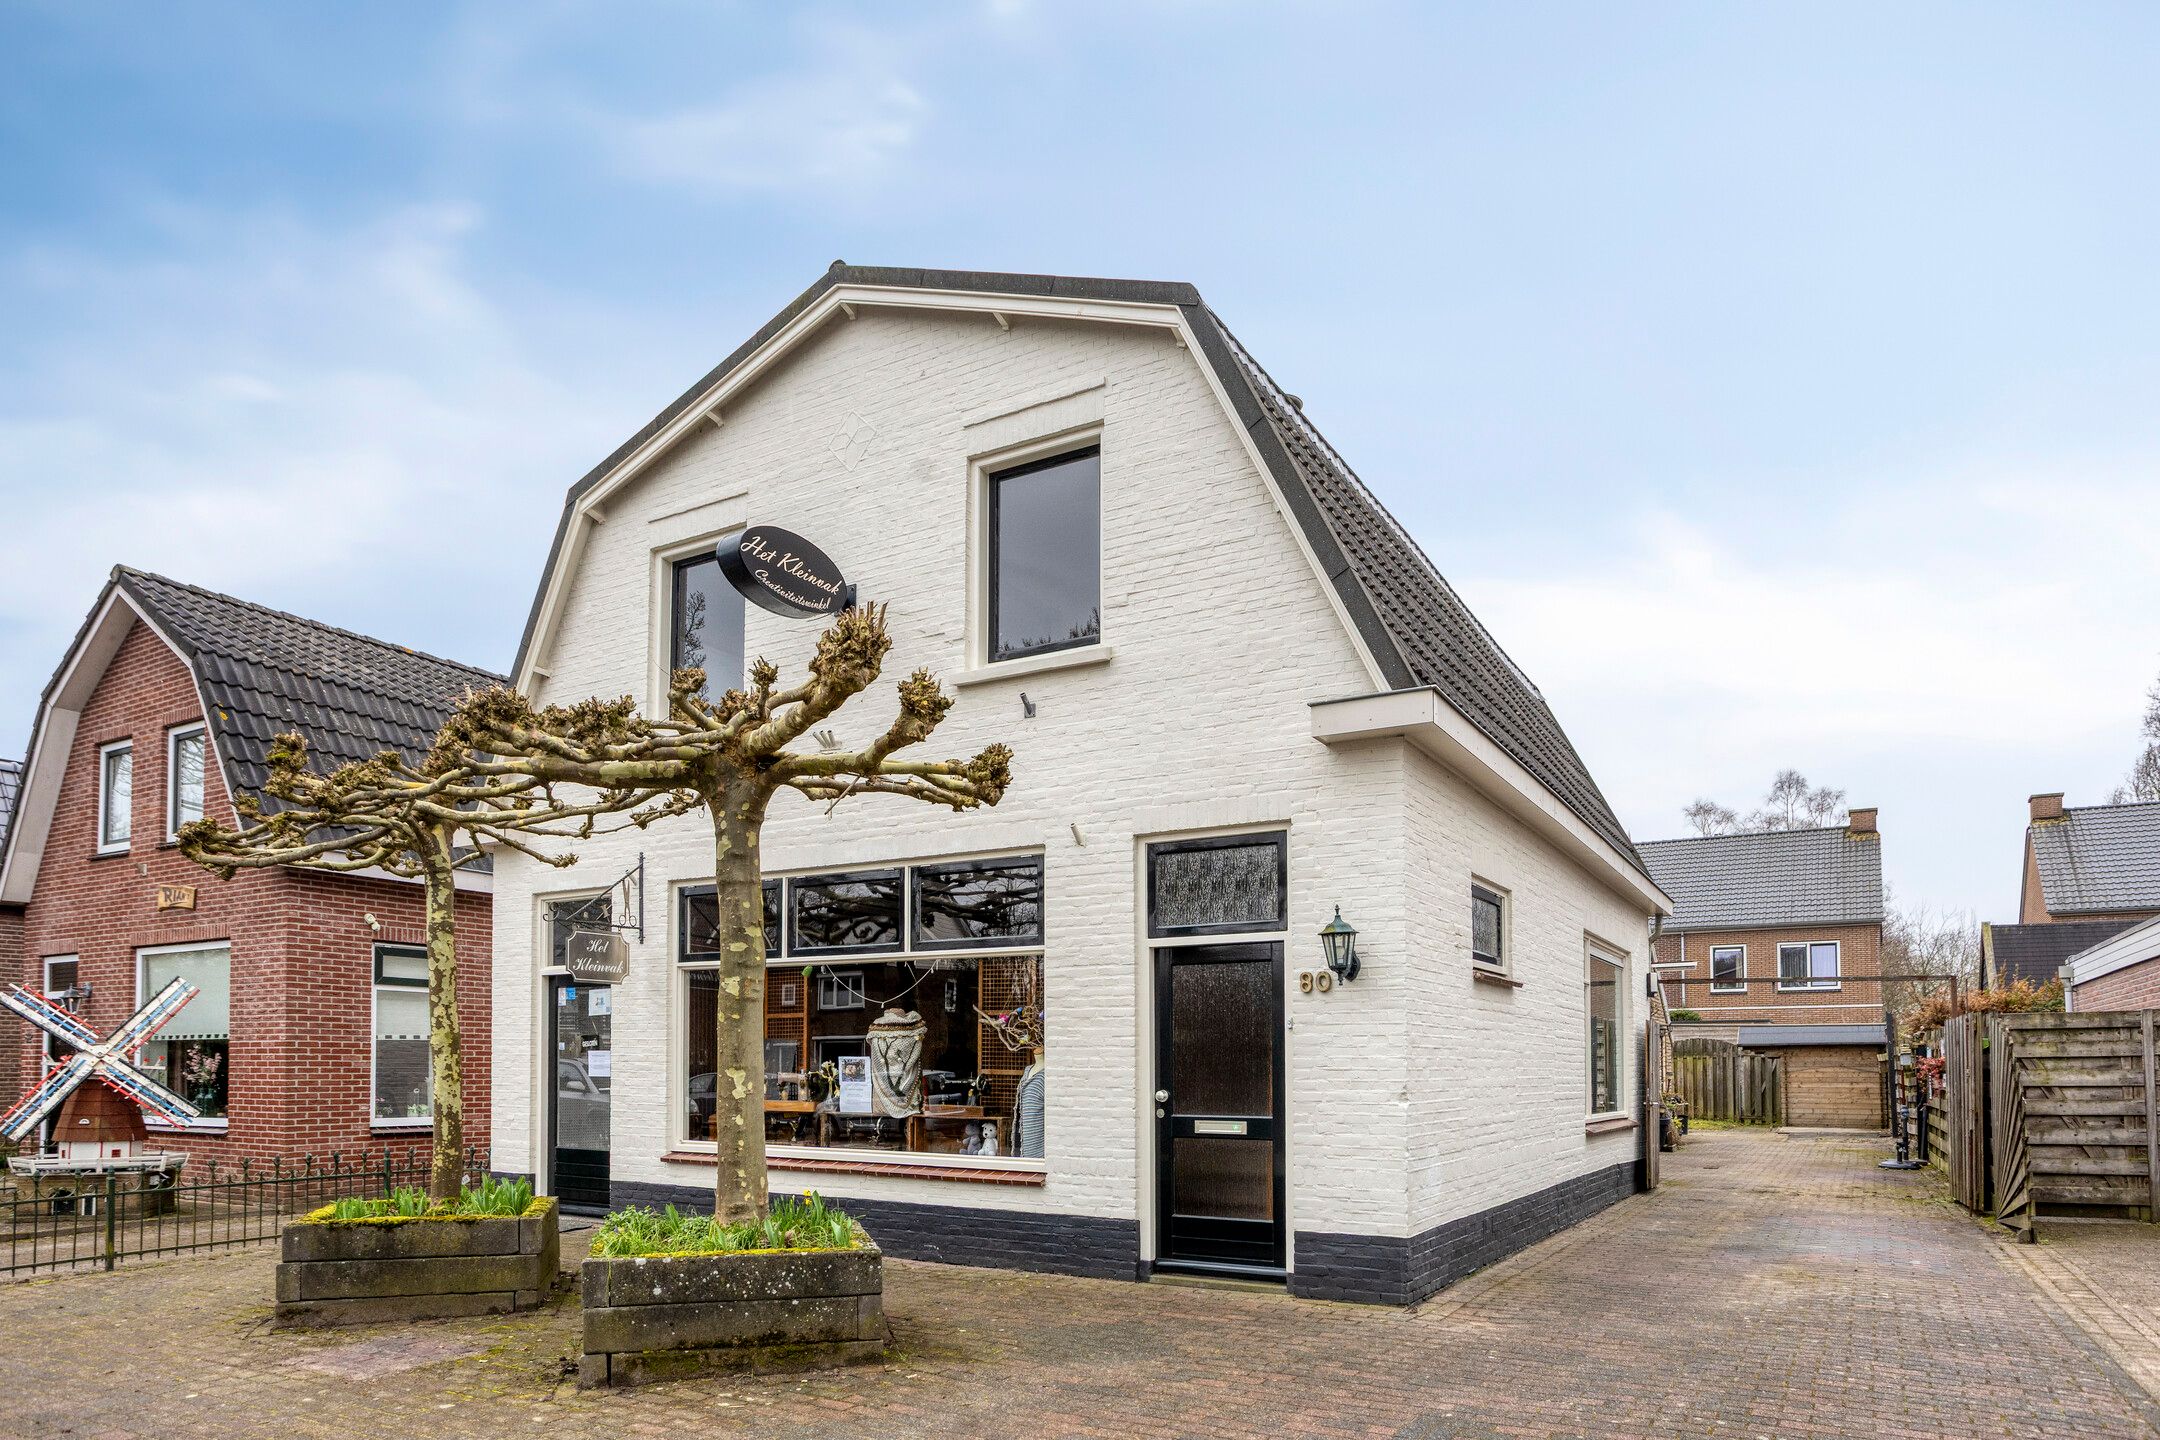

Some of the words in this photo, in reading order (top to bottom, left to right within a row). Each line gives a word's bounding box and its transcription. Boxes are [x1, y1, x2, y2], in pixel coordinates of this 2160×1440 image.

[740, 536, 776, 563] Het
[777, 552, 842, 595] Kleinvak
[586, 938, 609, 953] Het
[572, 957, 624, 973] Kleinvak
[1300, 971, 1332, 993] 80
